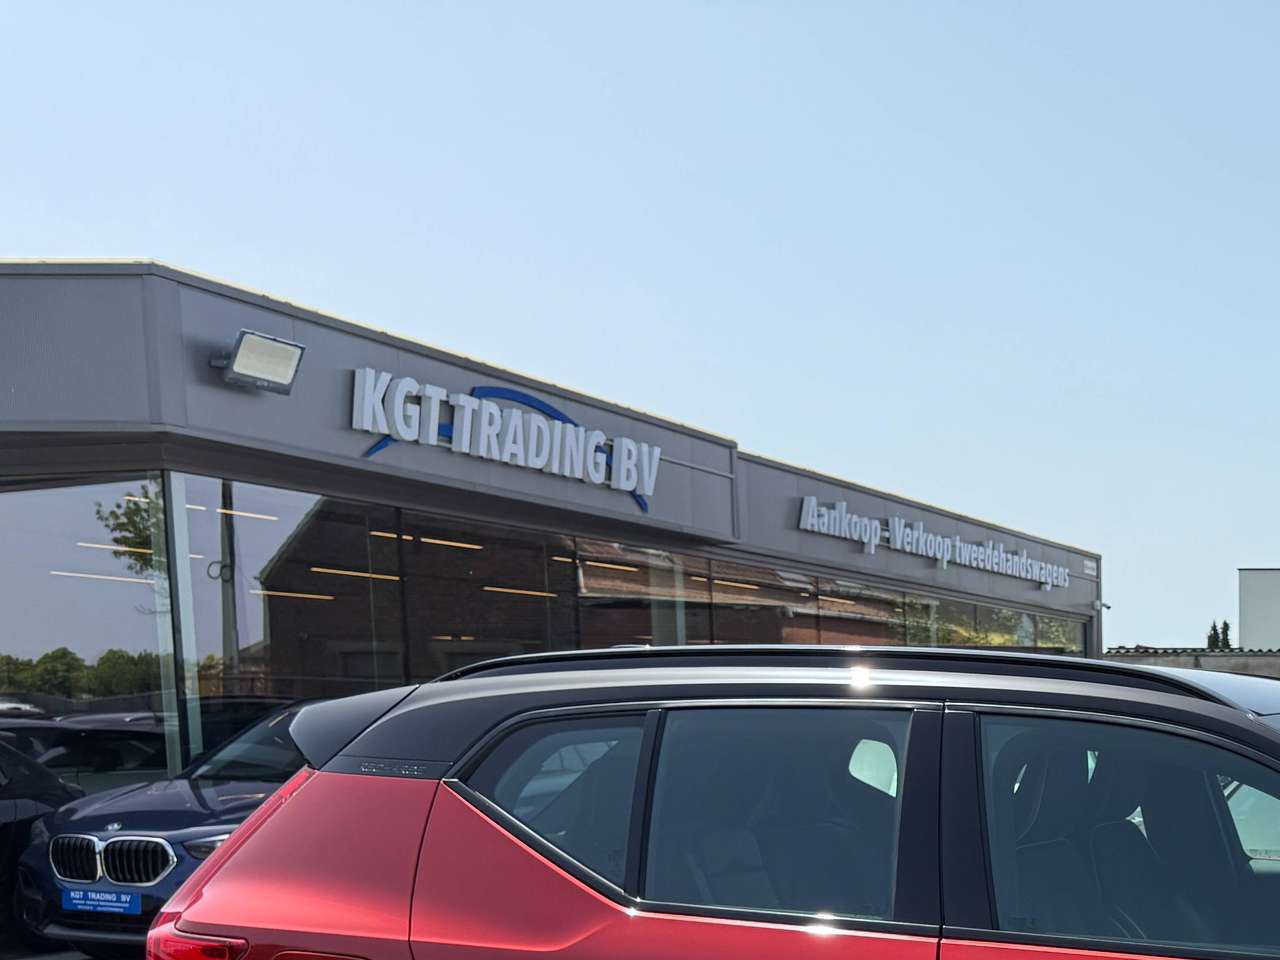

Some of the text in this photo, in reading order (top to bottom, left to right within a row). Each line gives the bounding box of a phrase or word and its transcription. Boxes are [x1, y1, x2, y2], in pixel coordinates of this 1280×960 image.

[352, 367, 661, 496] KGT TRADING BV
[799, 495, 881, 554] Aankoop
[889, 516, 952, 570] Verkoop
[952, 535, 1070, 591] tweedehandswagens
[70, 891, 84, 899] KGT
[88, 891, 117, 902] TRADING
